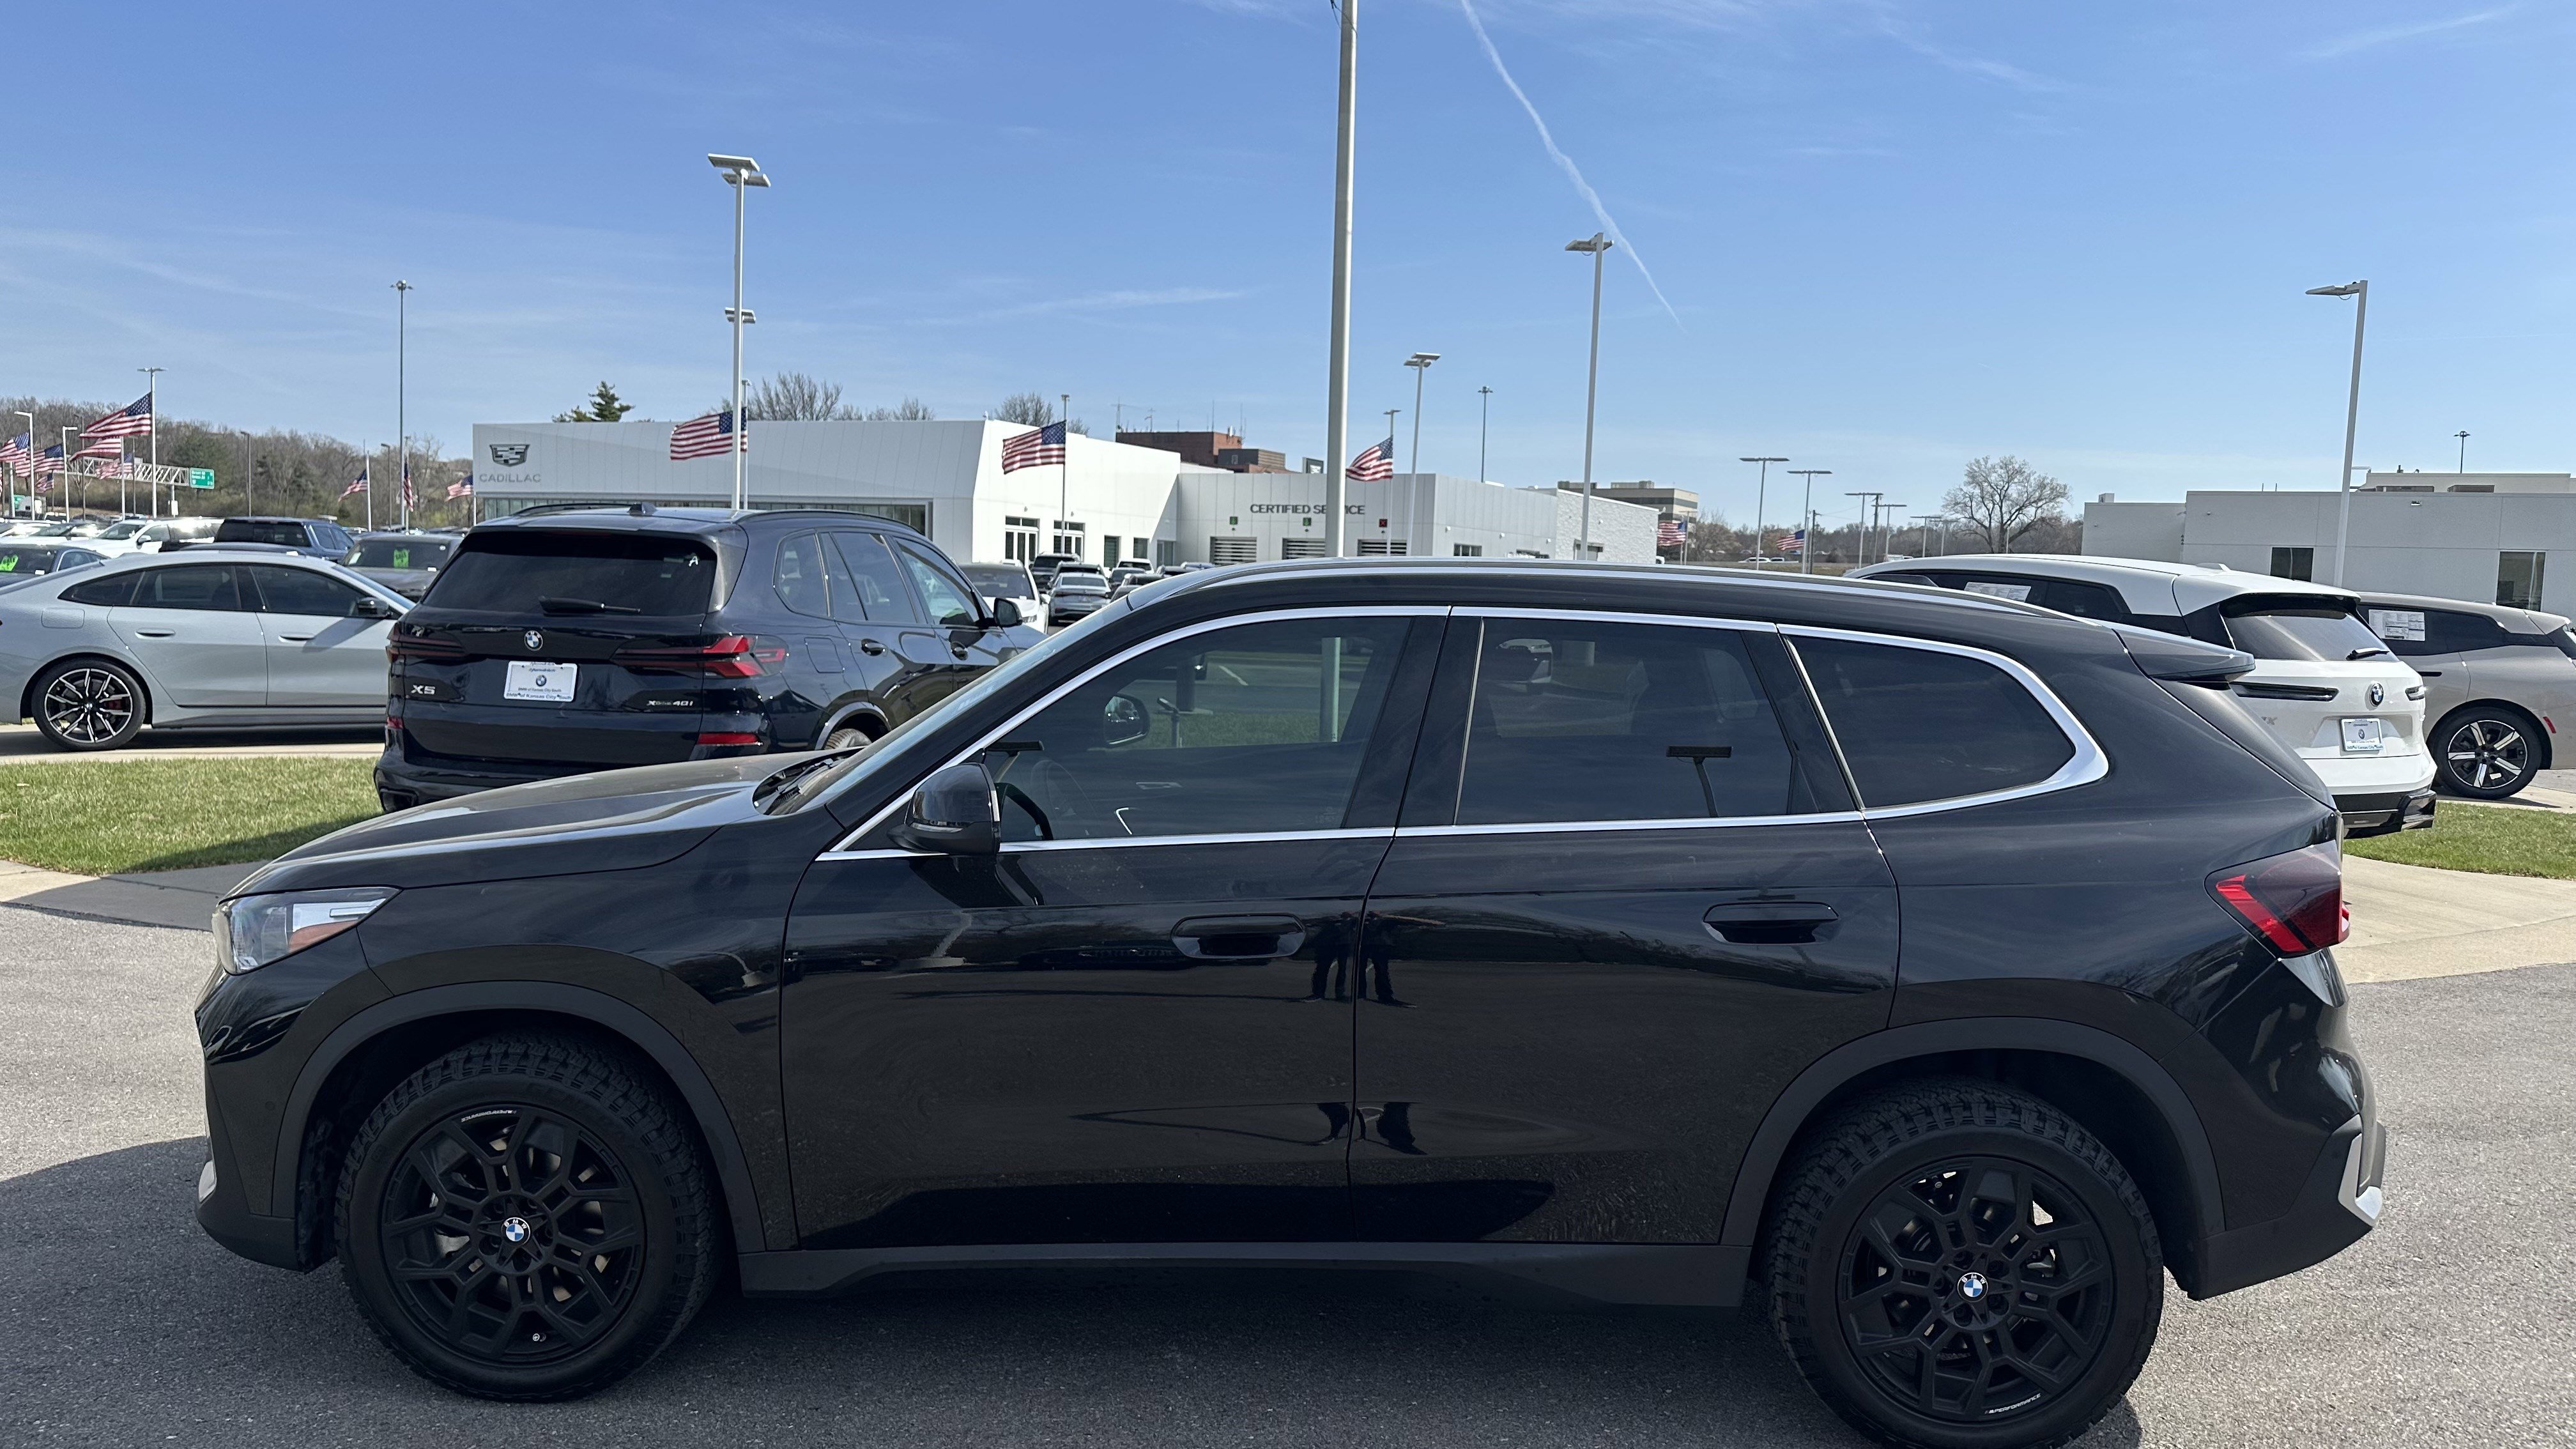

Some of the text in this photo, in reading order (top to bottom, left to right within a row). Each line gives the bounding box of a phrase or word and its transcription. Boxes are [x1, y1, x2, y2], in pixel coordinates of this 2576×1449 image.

[479, 473, 541, 483] CADILLAC
[1250, 503, 1365, 515] CERTIFIED SEICE
[411, 684, 436, 695] X5
